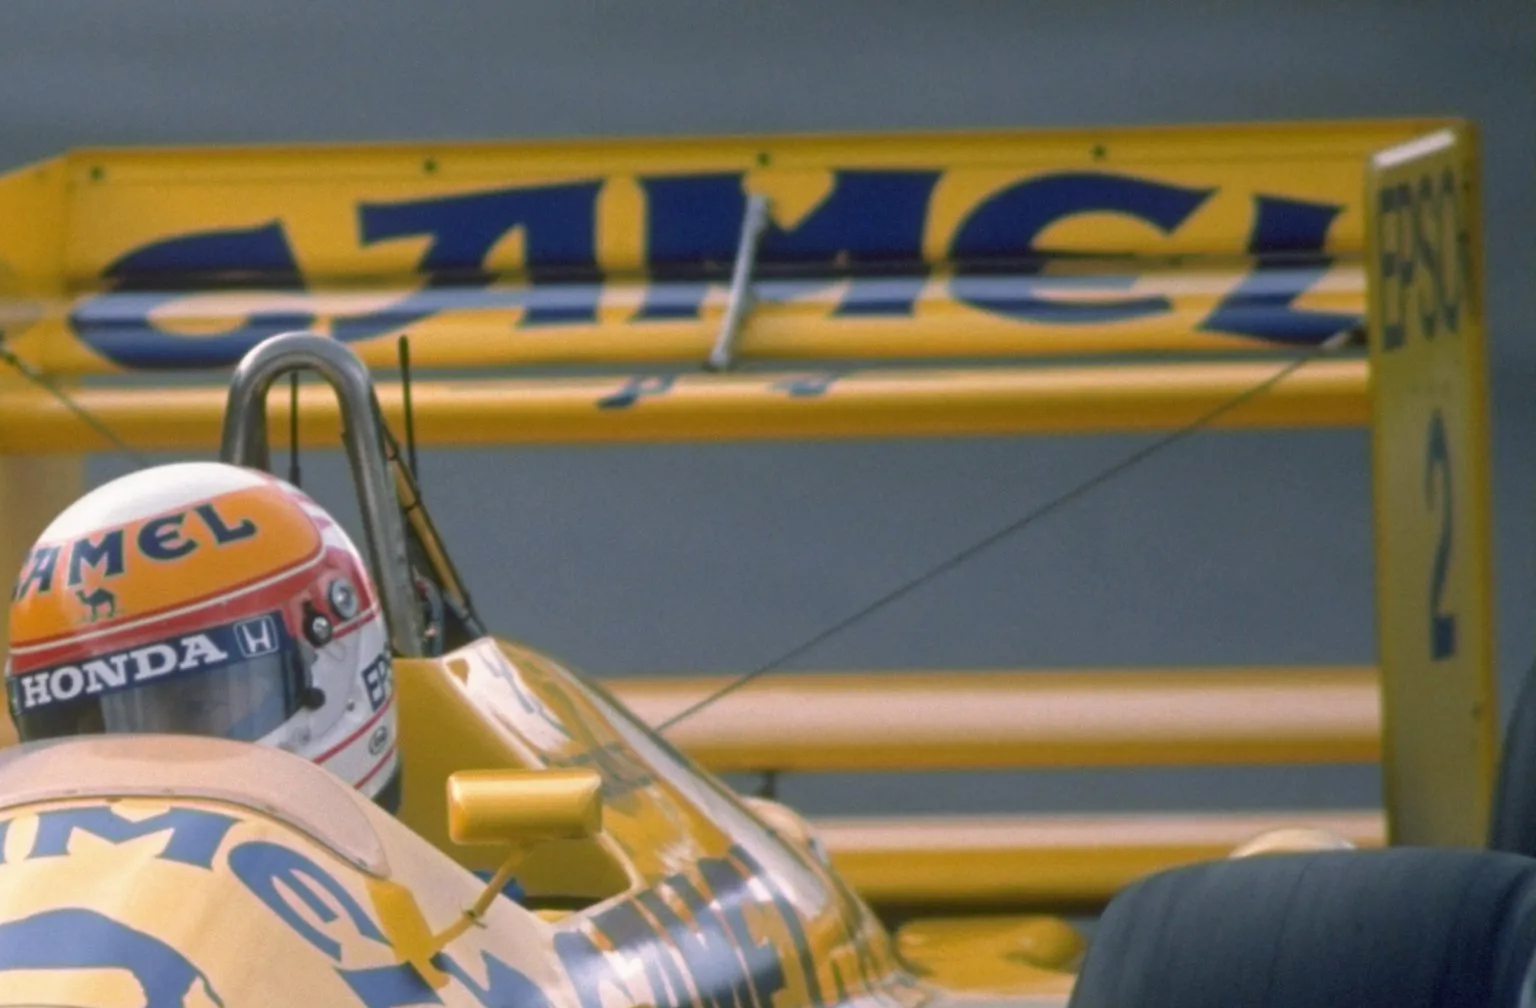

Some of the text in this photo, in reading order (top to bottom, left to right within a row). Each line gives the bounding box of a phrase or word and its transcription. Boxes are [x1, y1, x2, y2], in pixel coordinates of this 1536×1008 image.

[67, 170, 1368, 370] CAMEL
[11, 503, 256, 602] AMEL
[1427, 408, 1456, 660] 2
[20, 634, 228, 708] HONDA
